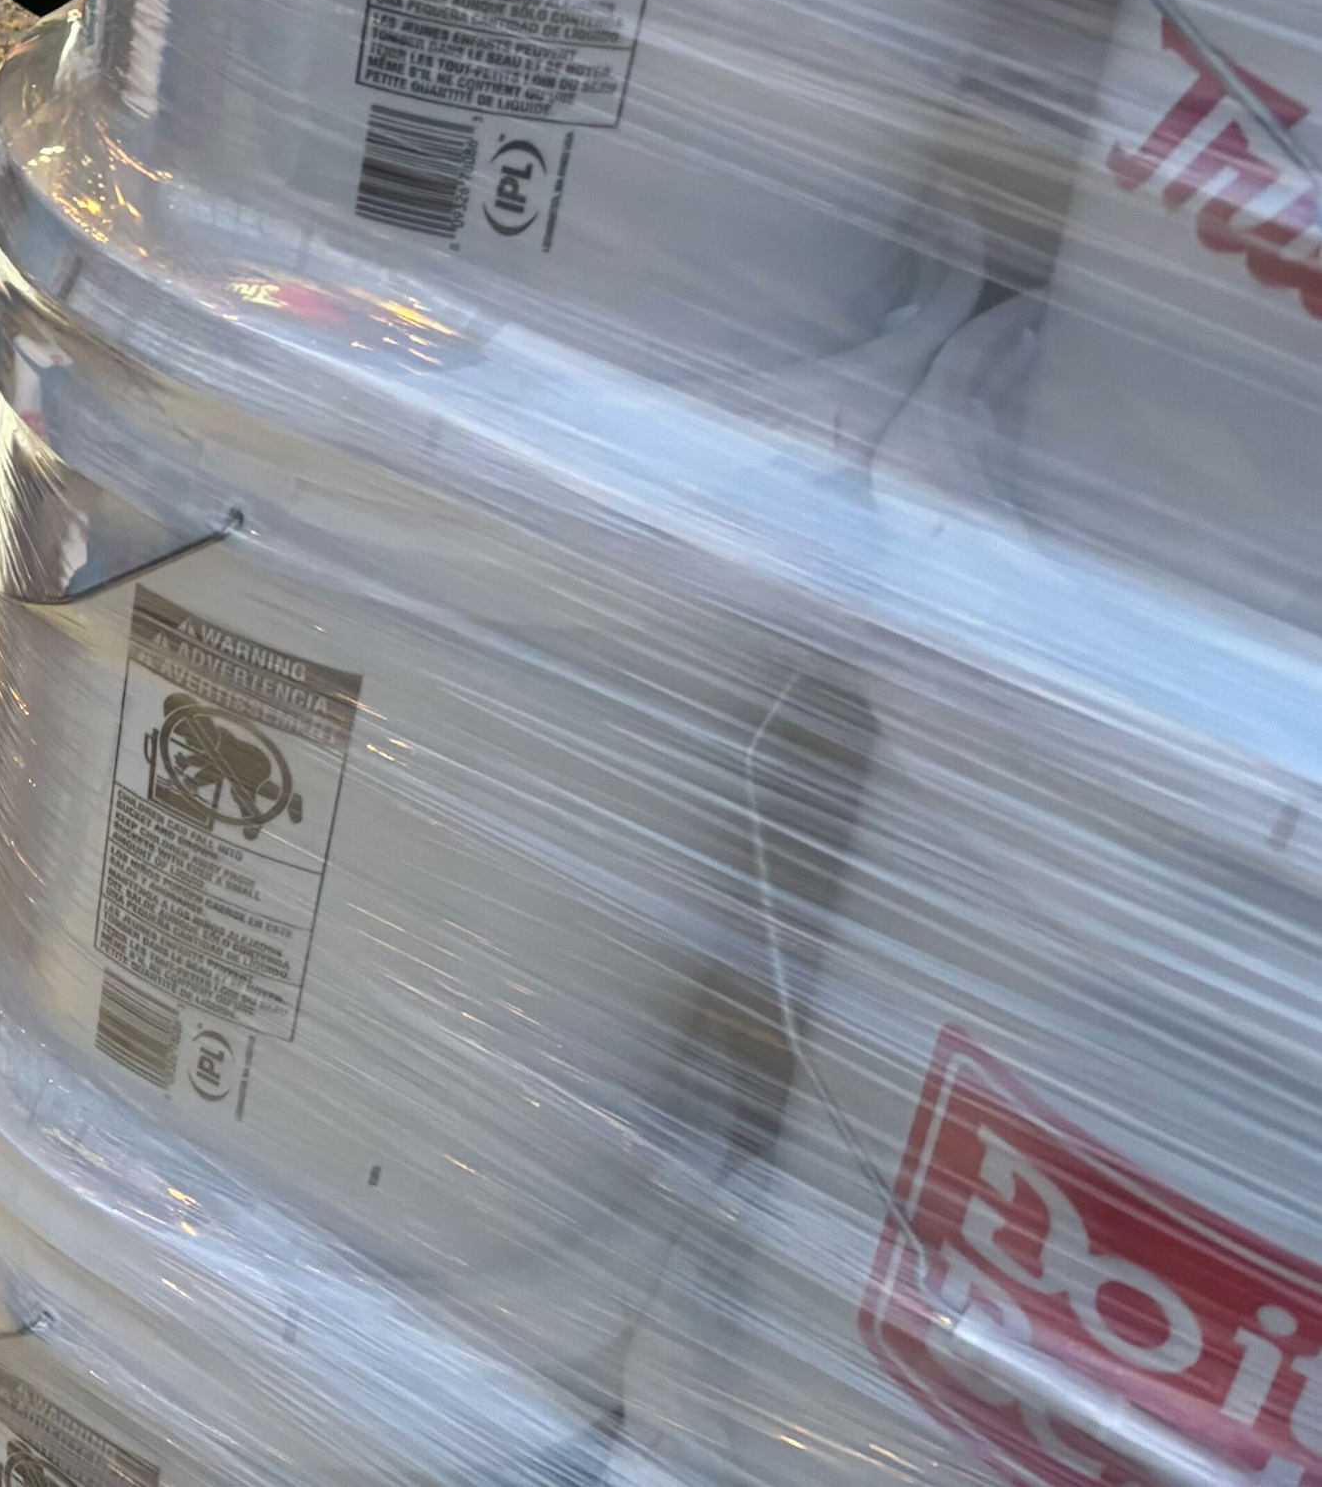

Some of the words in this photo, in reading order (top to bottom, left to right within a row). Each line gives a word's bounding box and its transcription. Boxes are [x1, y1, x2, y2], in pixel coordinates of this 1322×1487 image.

[176, 641, 329, 715] ADVERTENCIA
[201, 621, 308, 684] WARNING
[960, 1122, 1204, 1375] Do
